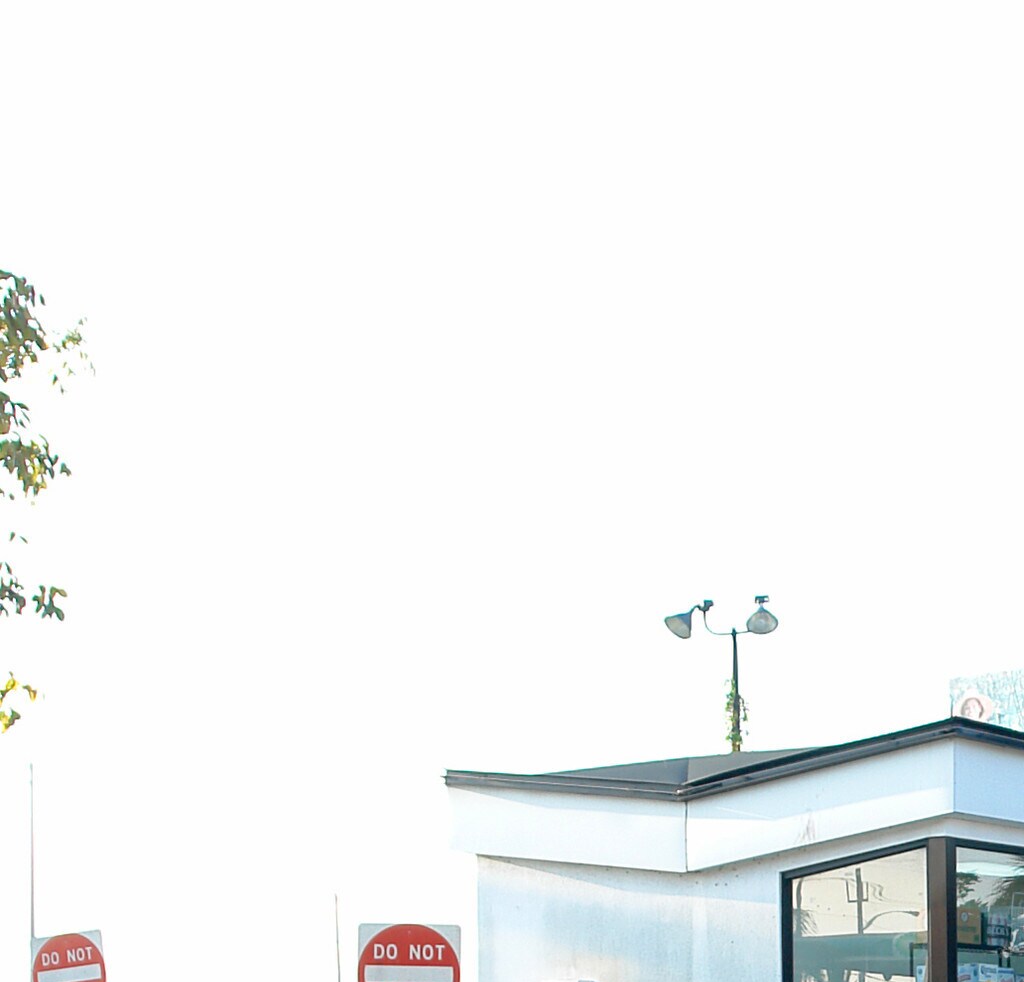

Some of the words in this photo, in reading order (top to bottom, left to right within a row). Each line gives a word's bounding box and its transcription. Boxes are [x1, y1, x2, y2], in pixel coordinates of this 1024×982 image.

[41, 951, 60, 966] DO
[66, 947, 92, 963] NOT
[373, 943, 398, 960] DO
[409, 944, 445, 960] NOT
